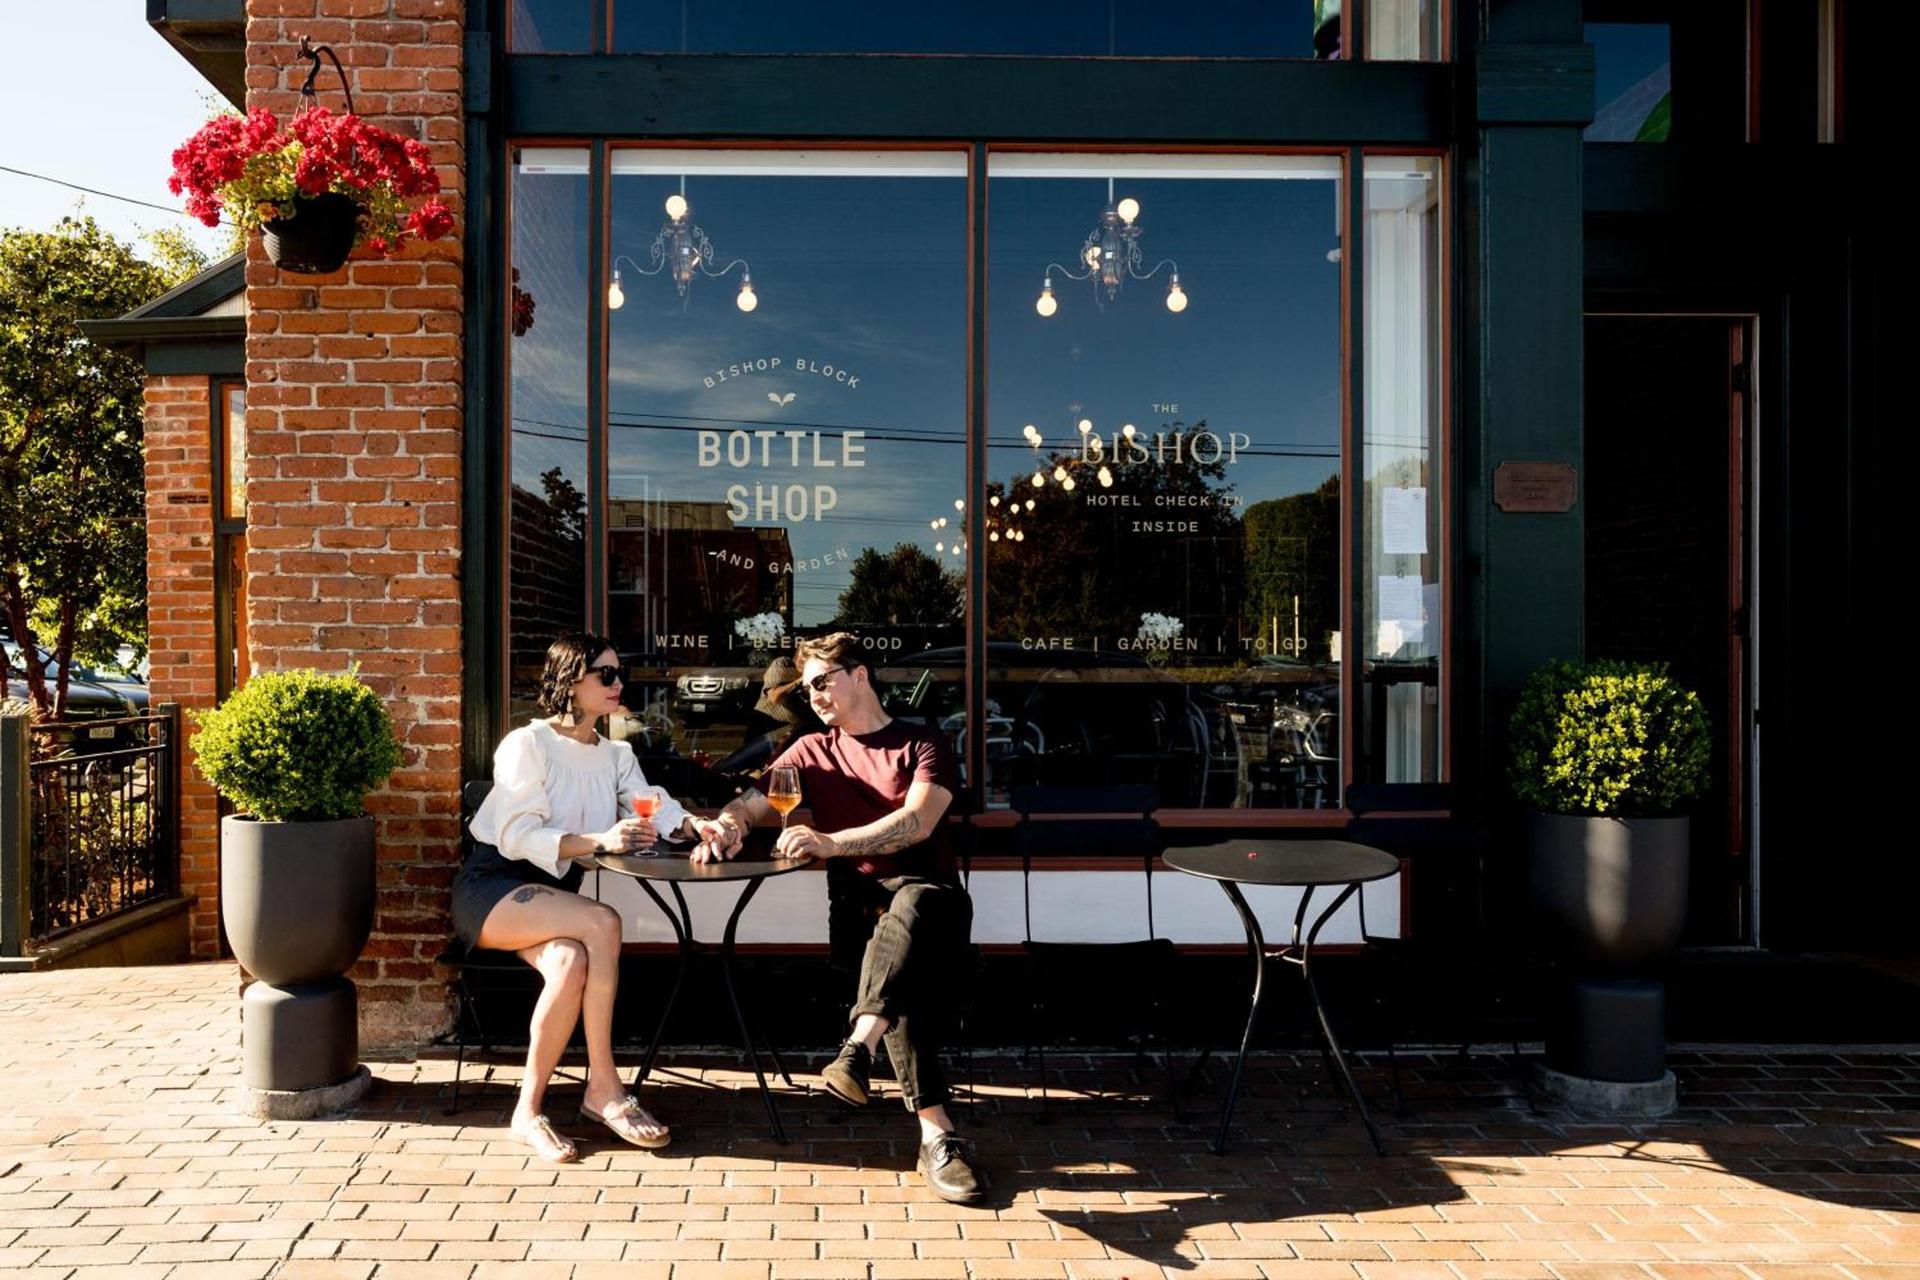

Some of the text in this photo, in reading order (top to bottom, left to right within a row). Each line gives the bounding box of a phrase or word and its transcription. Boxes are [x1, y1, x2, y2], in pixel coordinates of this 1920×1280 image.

[703, 357, 860, 389] BISHOP BLOCK
[1152, 404, 1179, 414] THE
[698, 430, 866, 467] BOTTLE
[1080, 431, 1251, 465] BISHOP
[726, 484, 838, 522] SHOP
[1087, 495, 1244, 507] HOTEL CHECK IN
[1131, 521, 1199, 533] INSIDE
[716, 547, 848, 574] AND GARDEN
[655, 634, 709, 649] WINE
[1021, 637, 1074, 650] CAFE
[1117, 637, 1198, 650] GARDEN
[1241, 637, 1267, 650] TO
